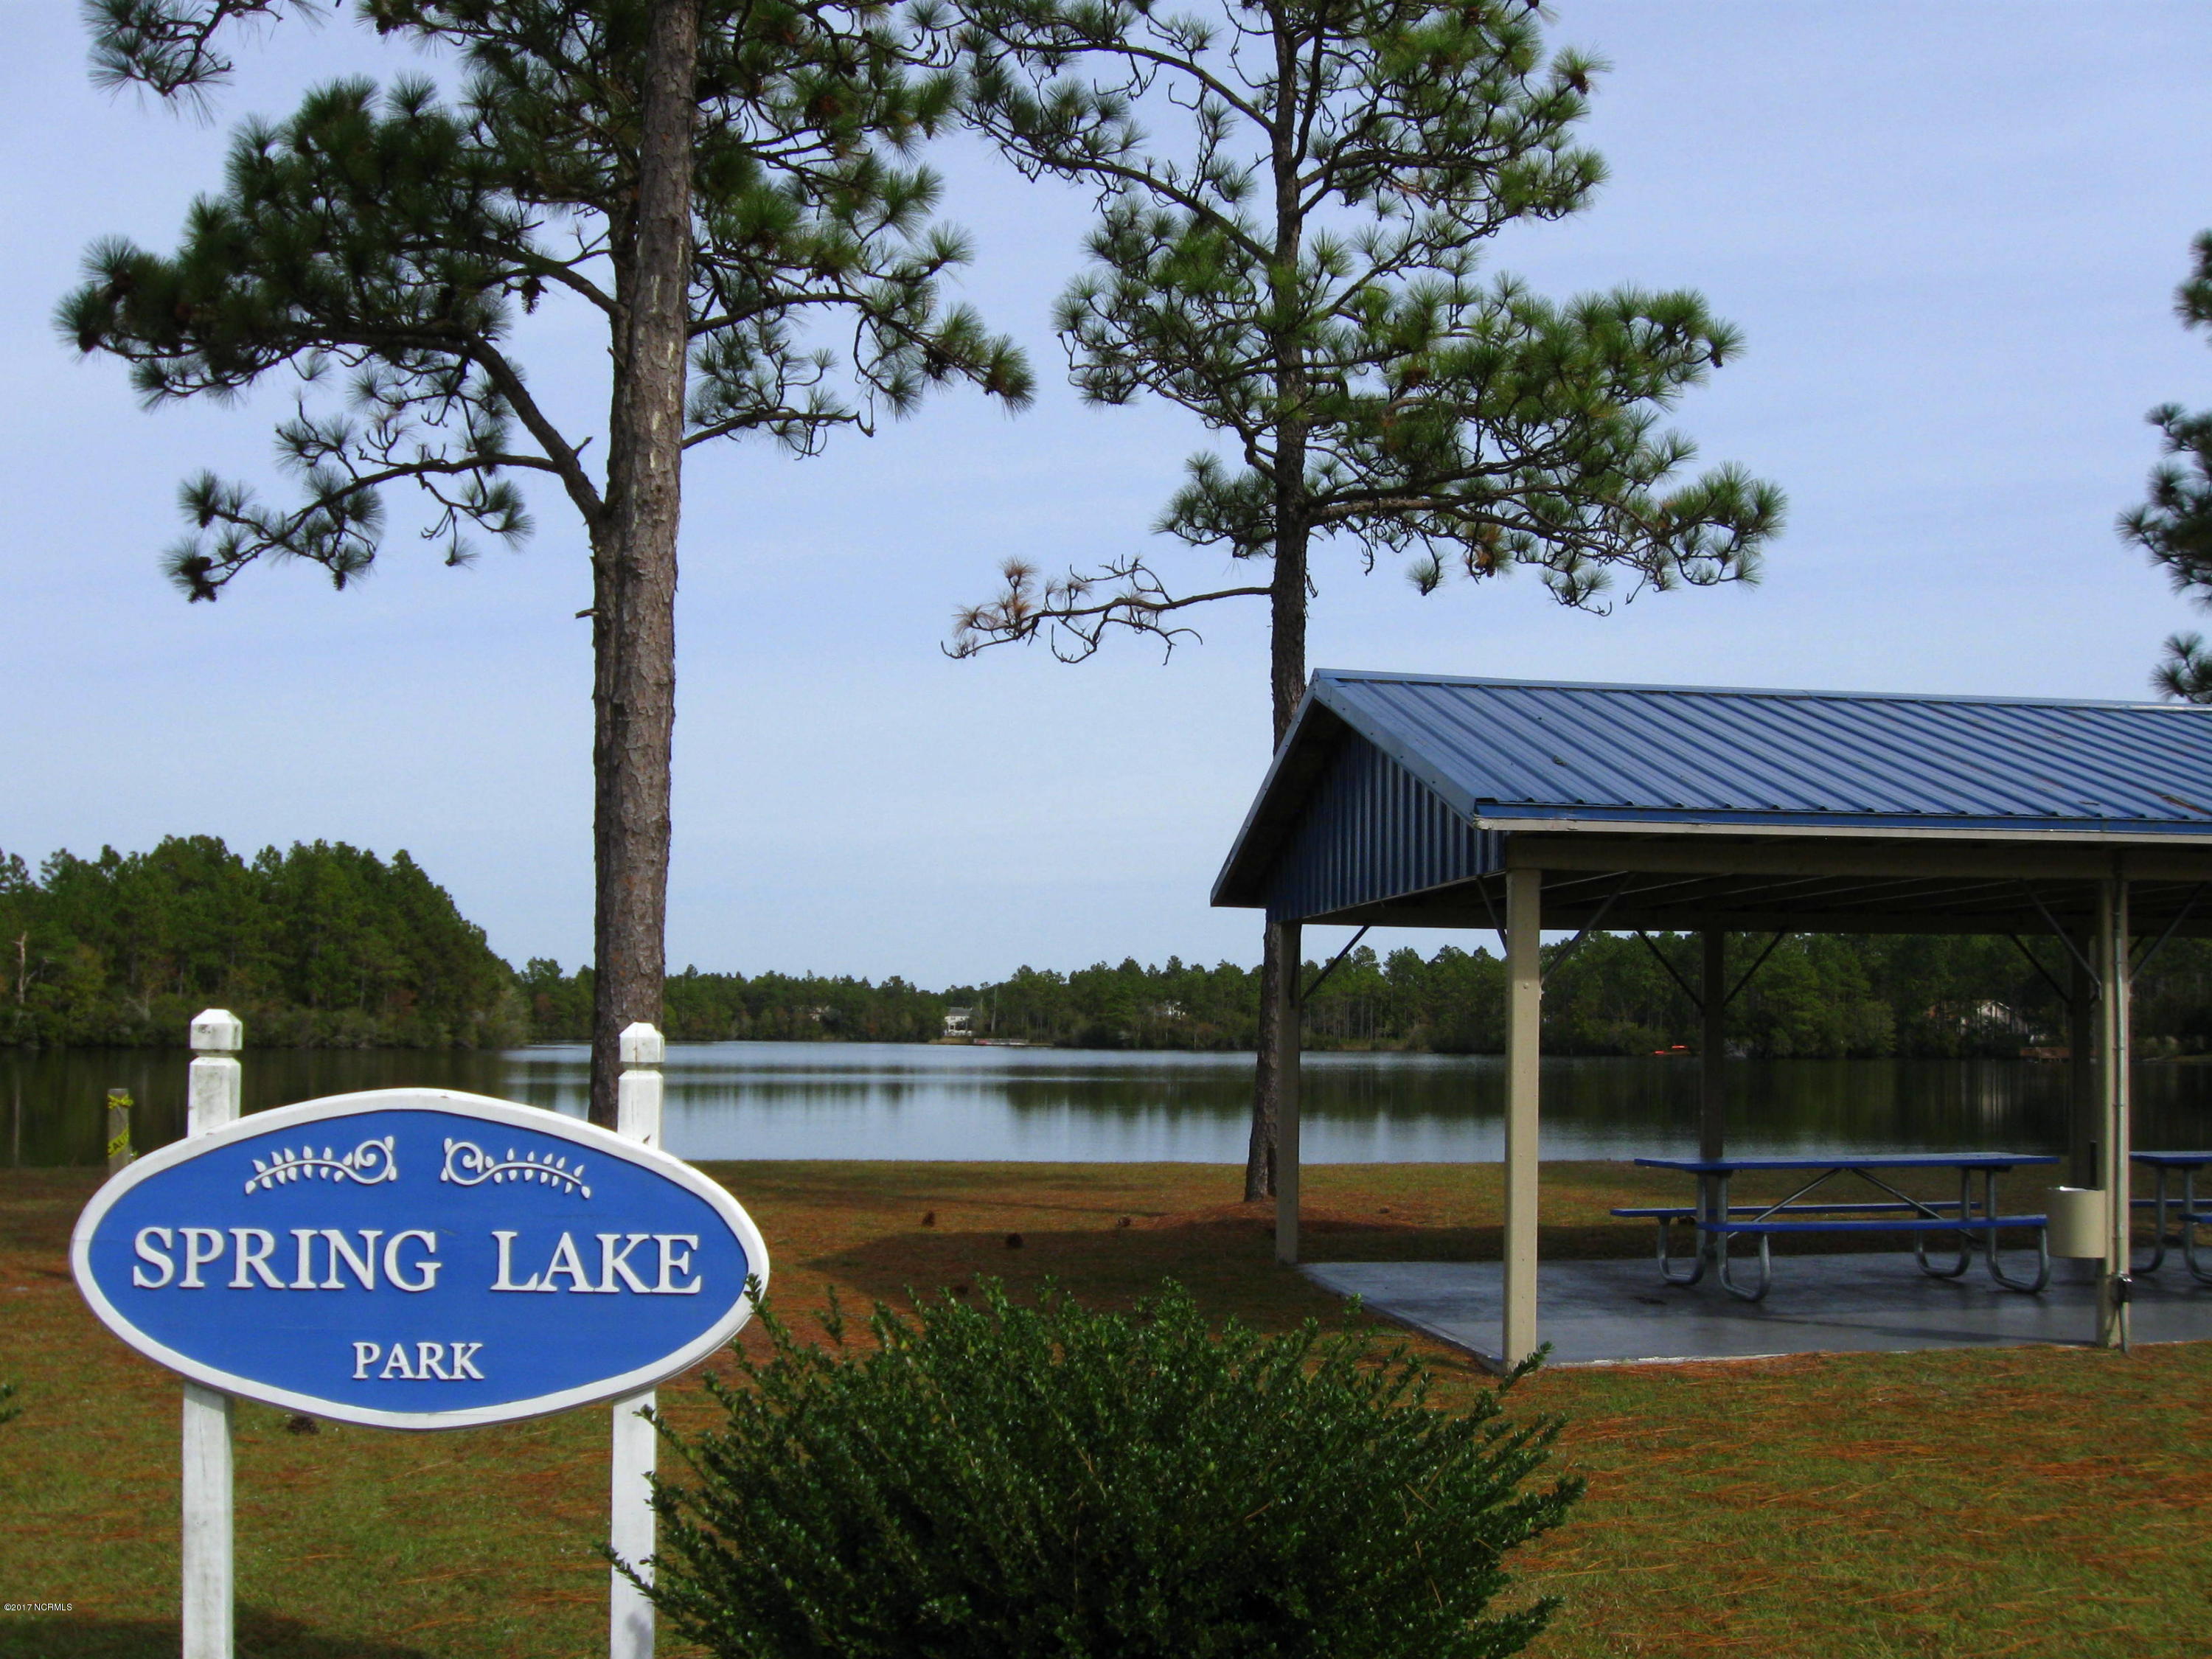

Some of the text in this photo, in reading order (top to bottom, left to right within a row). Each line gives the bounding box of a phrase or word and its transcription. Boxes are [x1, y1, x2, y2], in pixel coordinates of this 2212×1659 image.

[133, 1227, 701, 1294] SPRING LAKE
[352, 1342, 484, 1380] PARK
